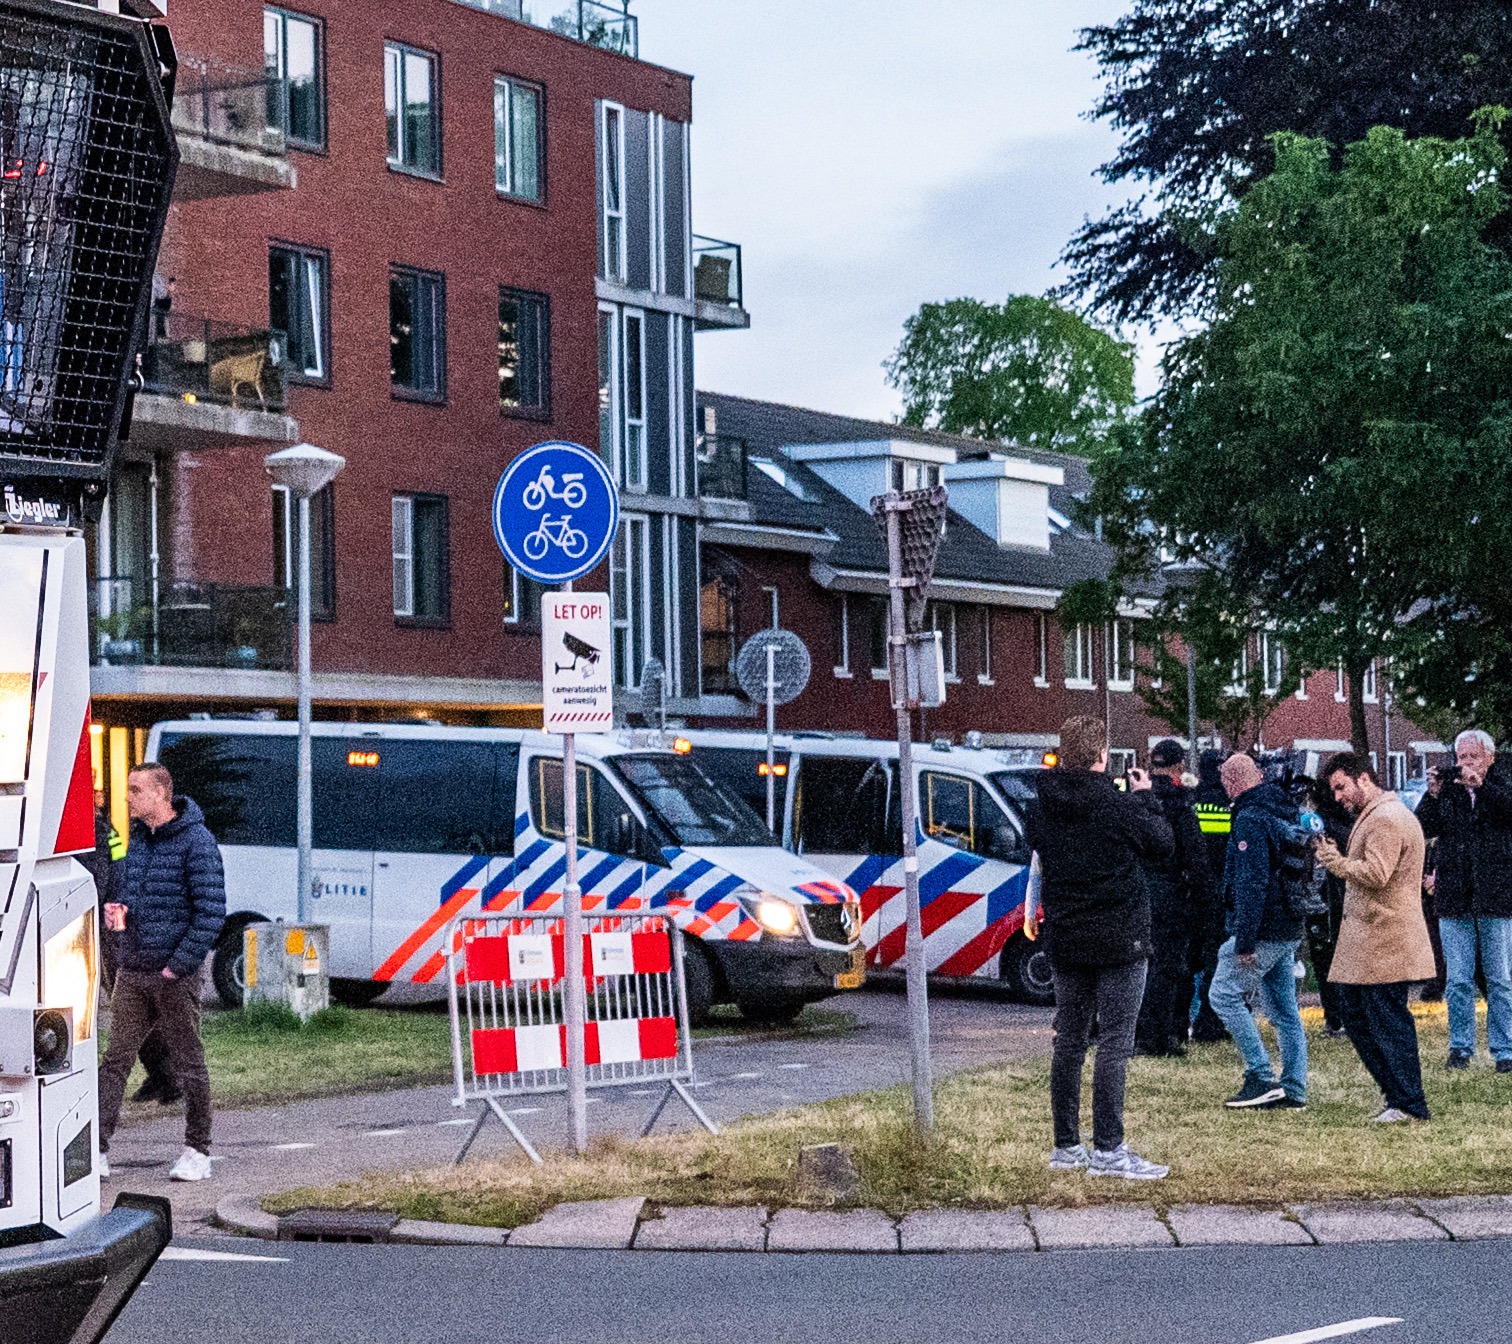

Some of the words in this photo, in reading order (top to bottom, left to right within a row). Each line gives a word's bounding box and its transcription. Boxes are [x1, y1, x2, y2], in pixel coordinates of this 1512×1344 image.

[4, 485, 61, 523] Ziegler
[554, 604, 577, 620] LET
[580, 605, 602, 620] OP!
[552, 684, 607, 694] cameratoezicht
[563, 695, 597, 706] aanwezig
